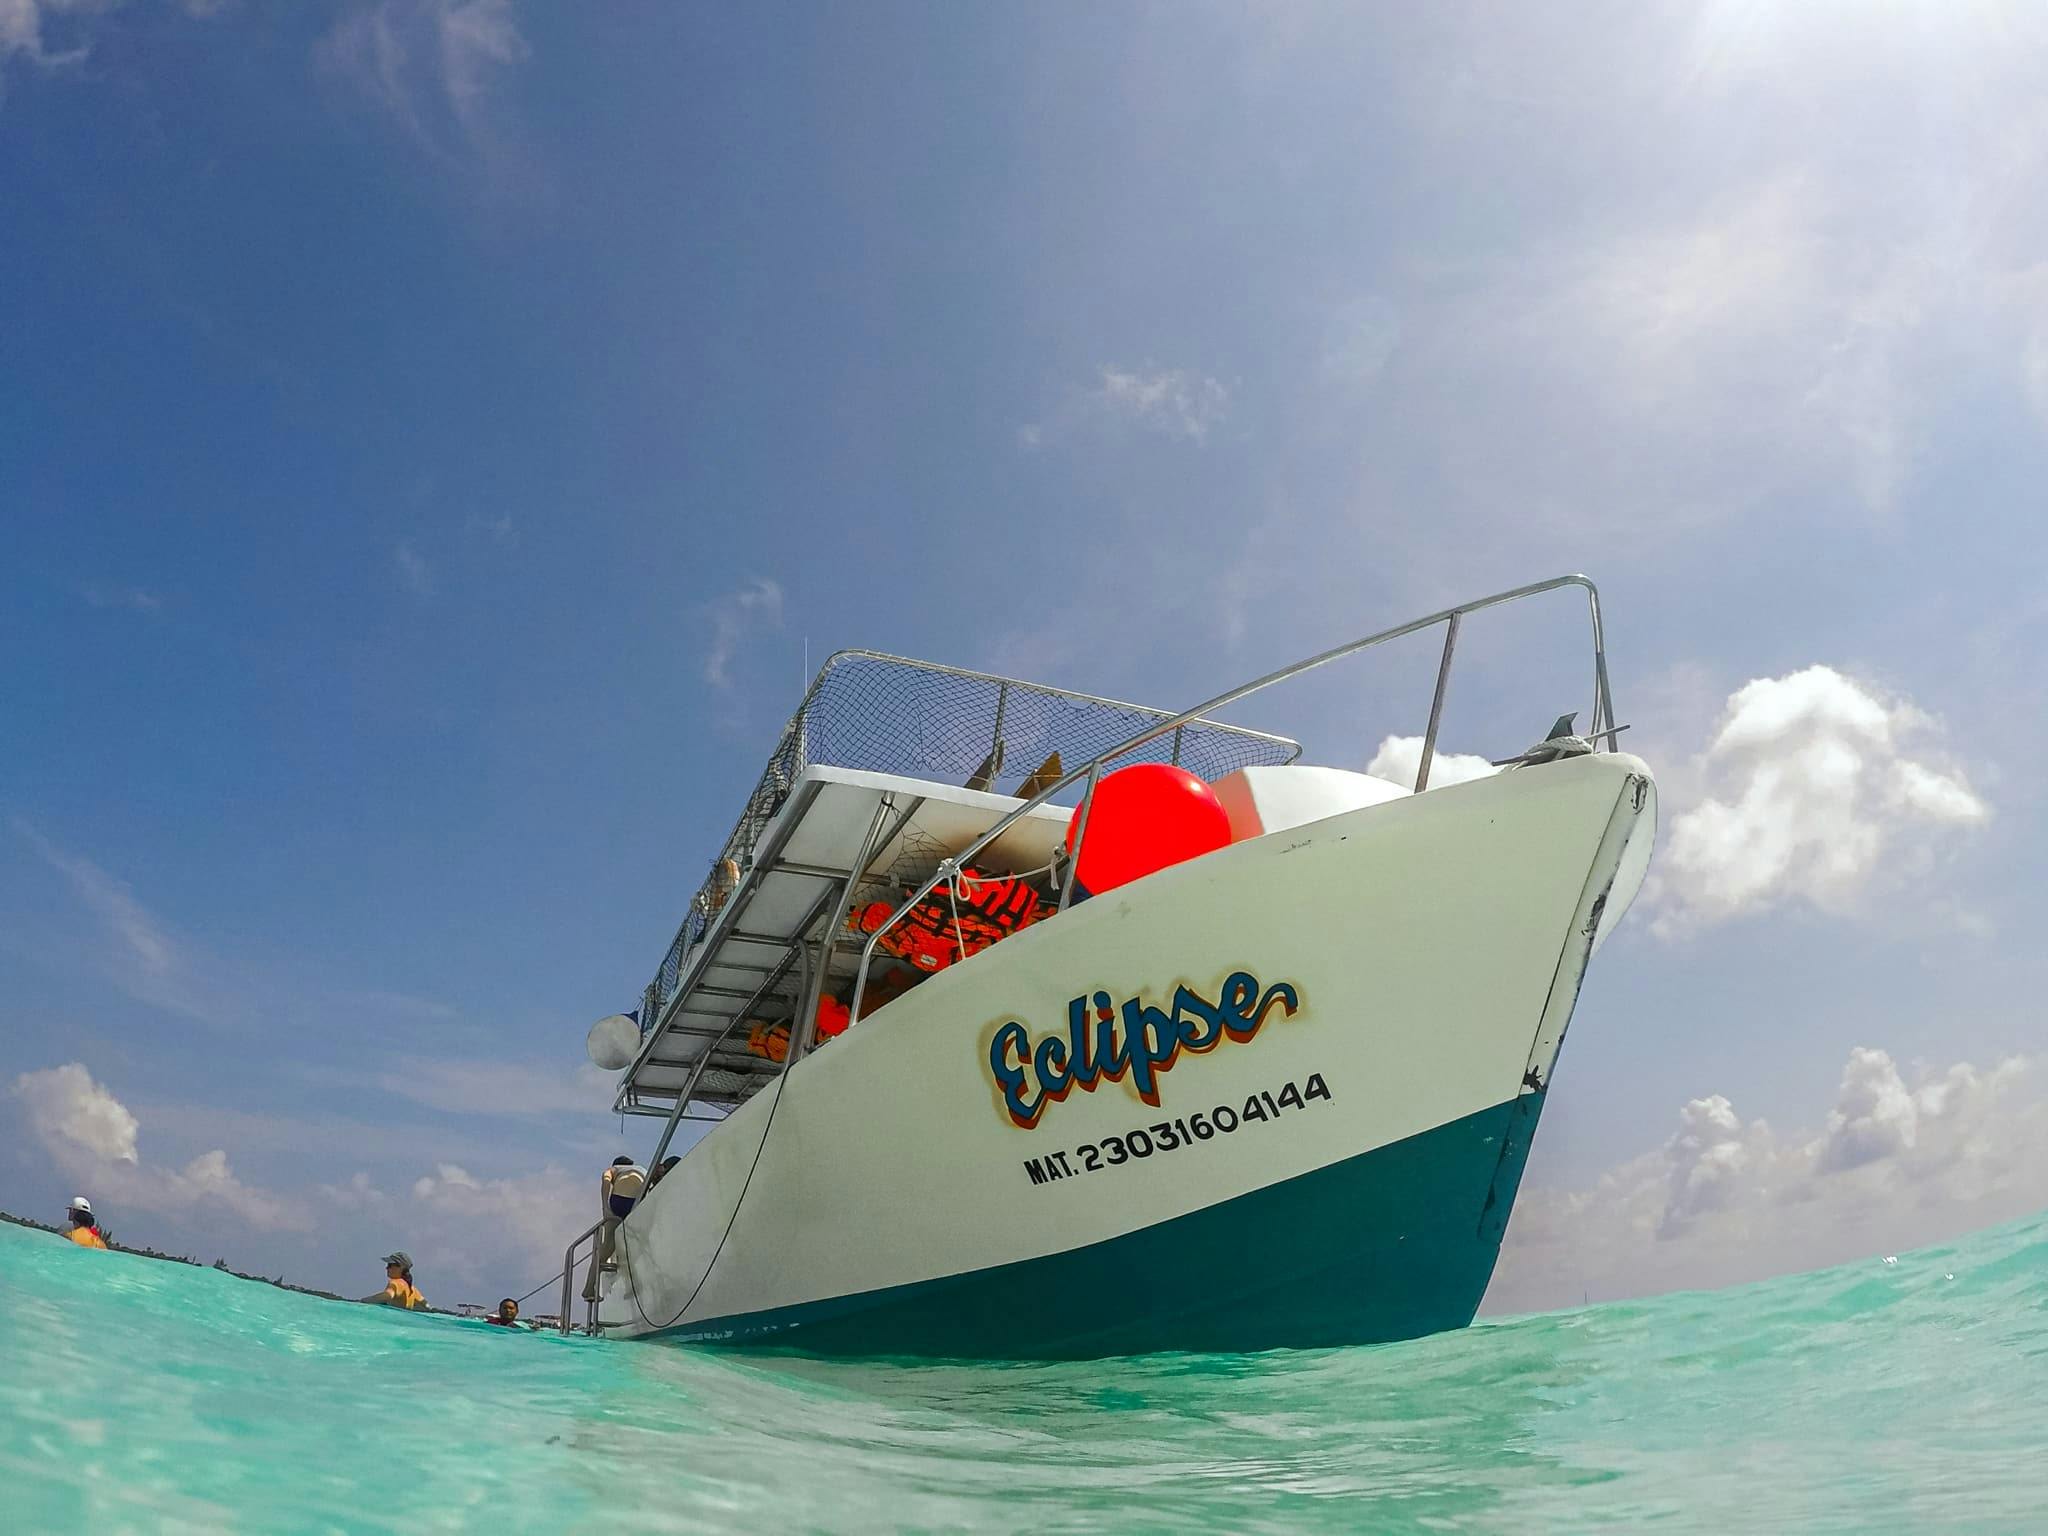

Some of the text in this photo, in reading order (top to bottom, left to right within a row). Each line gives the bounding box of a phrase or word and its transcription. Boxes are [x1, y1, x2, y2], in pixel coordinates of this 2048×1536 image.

[990, 972, 1298, 1130] Eclipse
[1024, 1073, 1332, 1185] MAT. 23031604144
